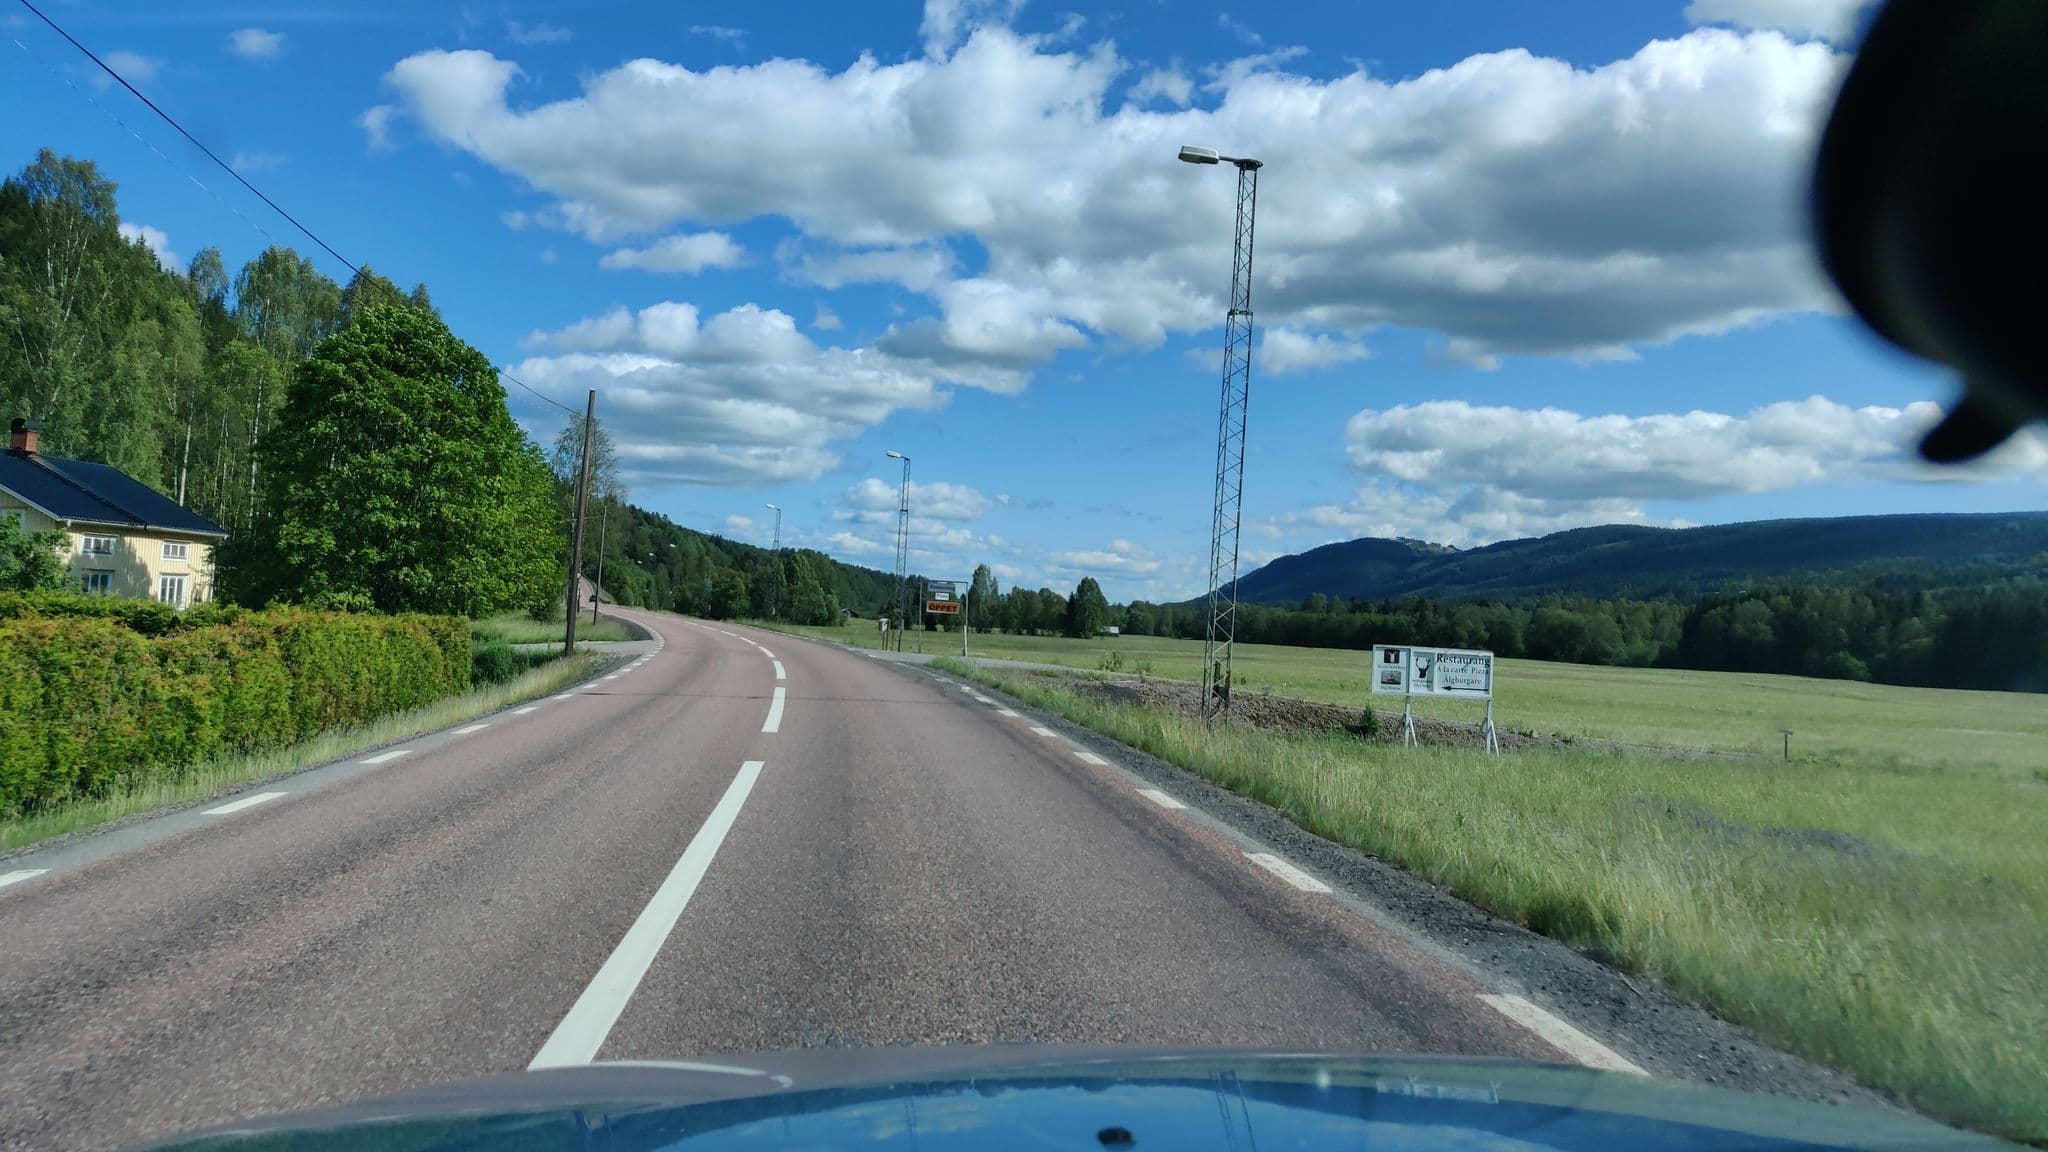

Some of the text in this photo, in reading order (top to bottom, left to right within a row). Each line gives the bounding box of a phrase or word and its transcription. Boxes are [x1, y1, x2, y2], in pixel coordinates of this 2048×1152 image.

[1437, 653, 1490, 669] Restaurang
[1443, 665, 1450, 673] la
[1471, 667, 1489, 675] Pizza
